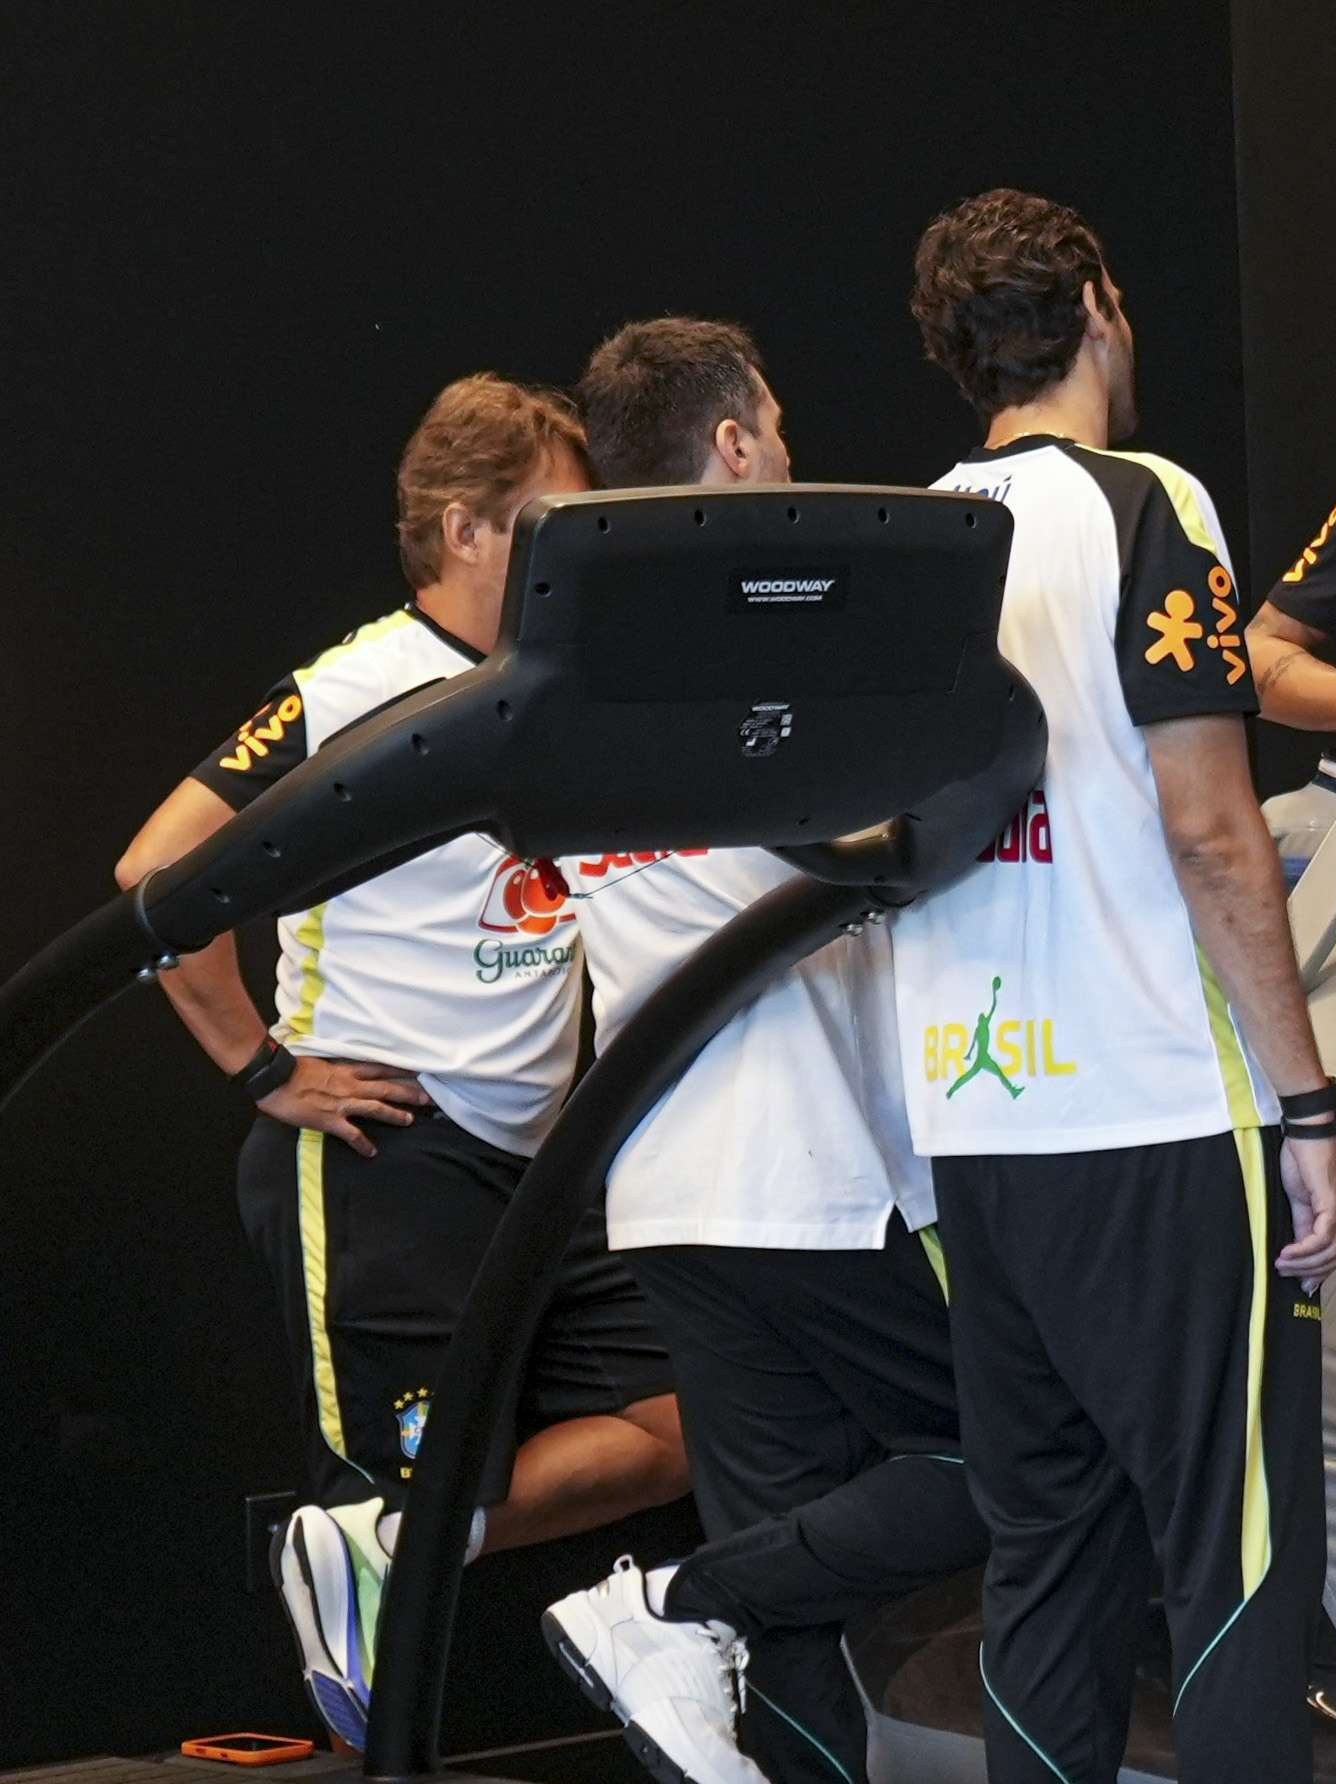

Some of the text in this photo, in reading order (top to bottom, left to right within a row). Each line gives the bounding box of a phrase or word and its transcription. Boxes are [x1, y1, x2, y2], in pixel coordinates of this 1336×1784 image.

[741, 580, 835, 593] WOODWAY
[1206, 565, 1246, 686] vivo
[219, 695, 302, 771] vivo
[473, 938, 576, 984] Guaran
[924, 1018, 1077, 1082] BRSIL
